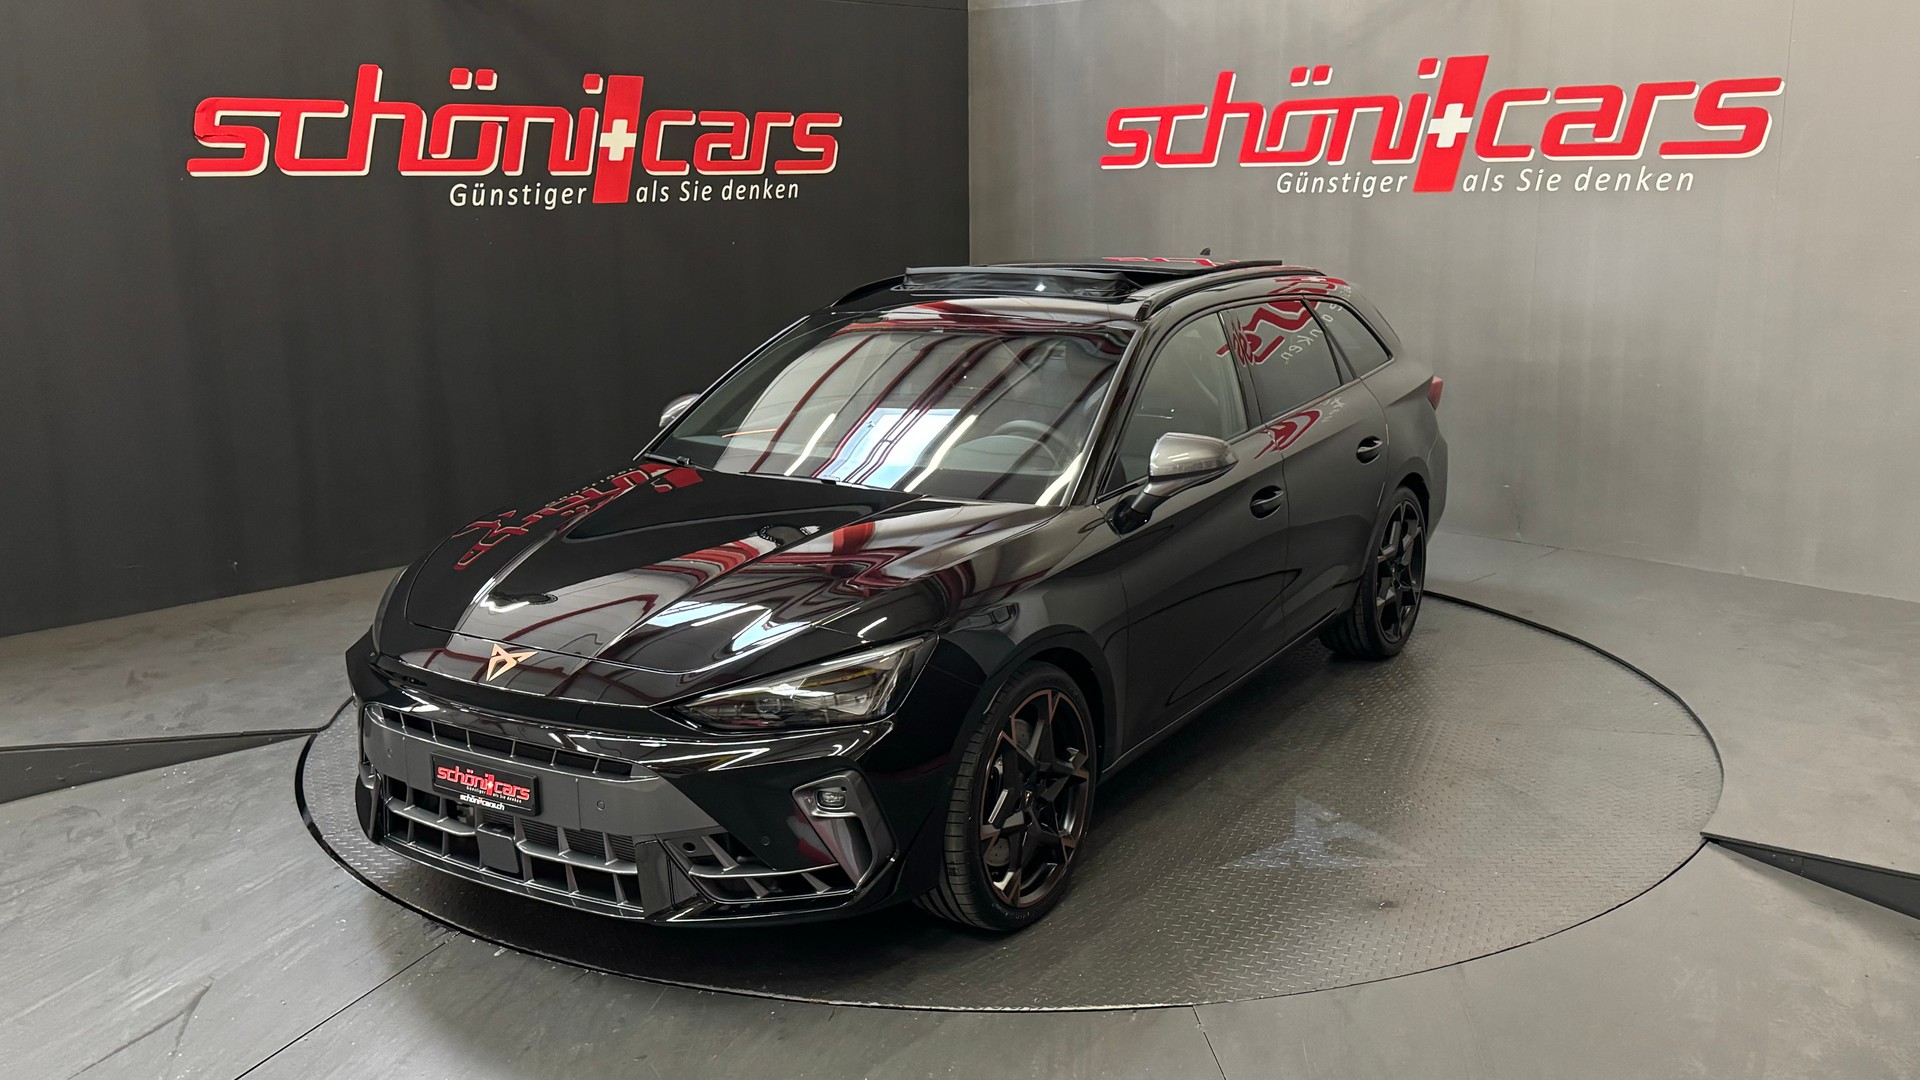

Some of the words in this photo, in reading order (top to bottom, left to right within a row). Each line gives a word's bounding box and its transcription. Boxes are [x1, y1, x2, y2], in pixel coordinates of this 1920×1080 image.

[450, 181, 588, 210] Günstiger
[636, 179, 670, 203] als
[679, 178, 713, 202] Sie
[721, 177, 800, 201] denken
[1276, 169, 1408, 197] Günstiger
[1462, 167, 1505, 192] als
[1516, 166, 1562, 192] Sie
[1574, 164, 1694, 193] denken
